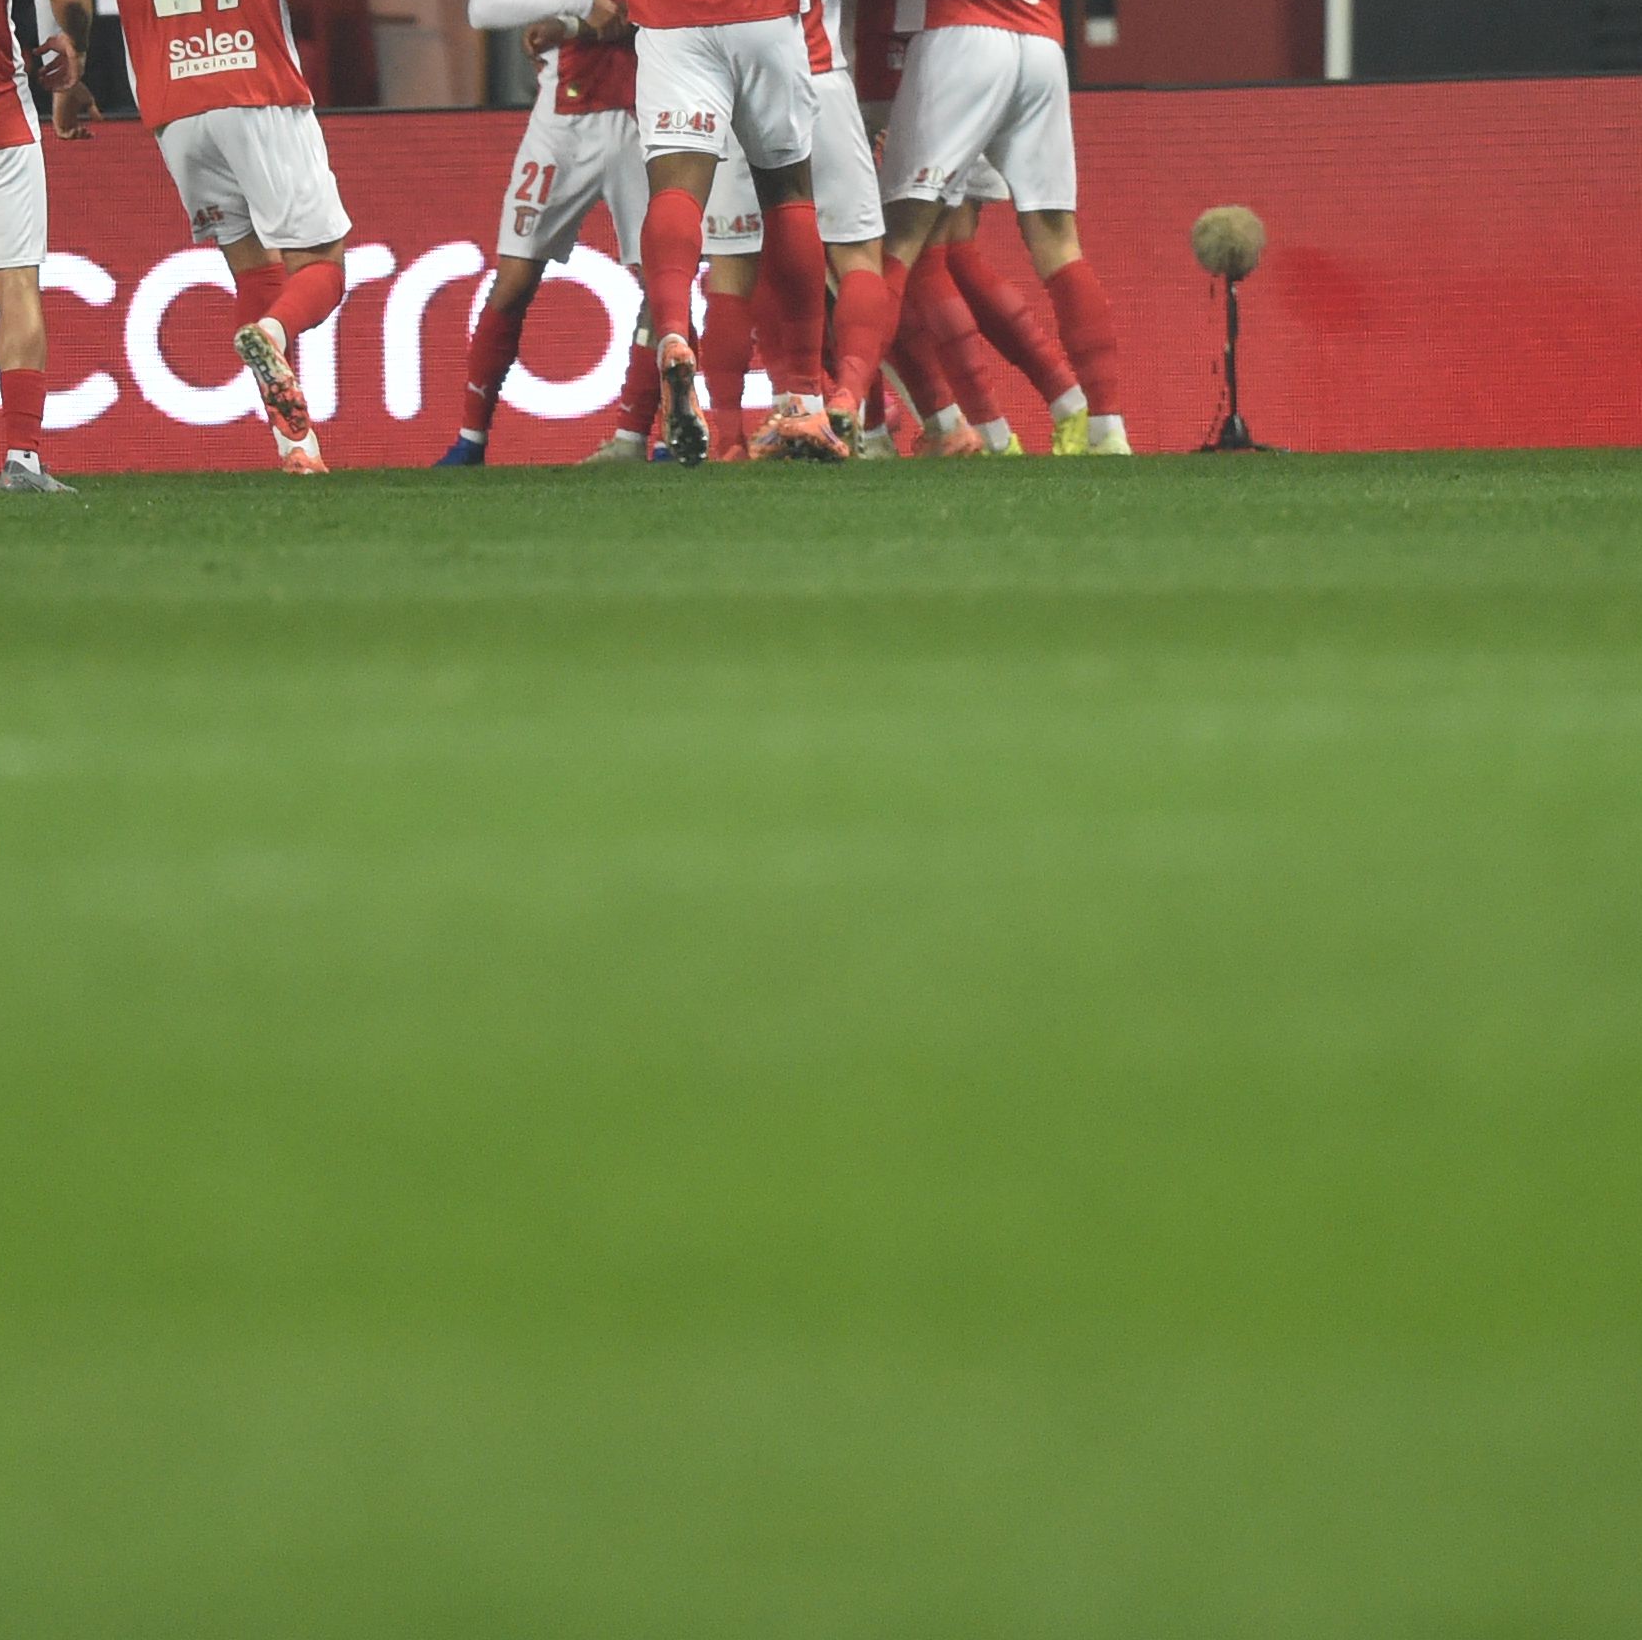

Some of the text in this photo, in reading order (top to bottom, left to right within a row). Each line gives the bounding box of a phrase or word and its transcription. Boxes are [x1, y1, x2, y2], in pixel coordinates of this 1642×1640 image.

[168, 27, 255, 61] soleo
[177, 55, 249, 77] piscinas
[655, 110, 717, 134] 2045
[515, 161, 557, 205] 21
